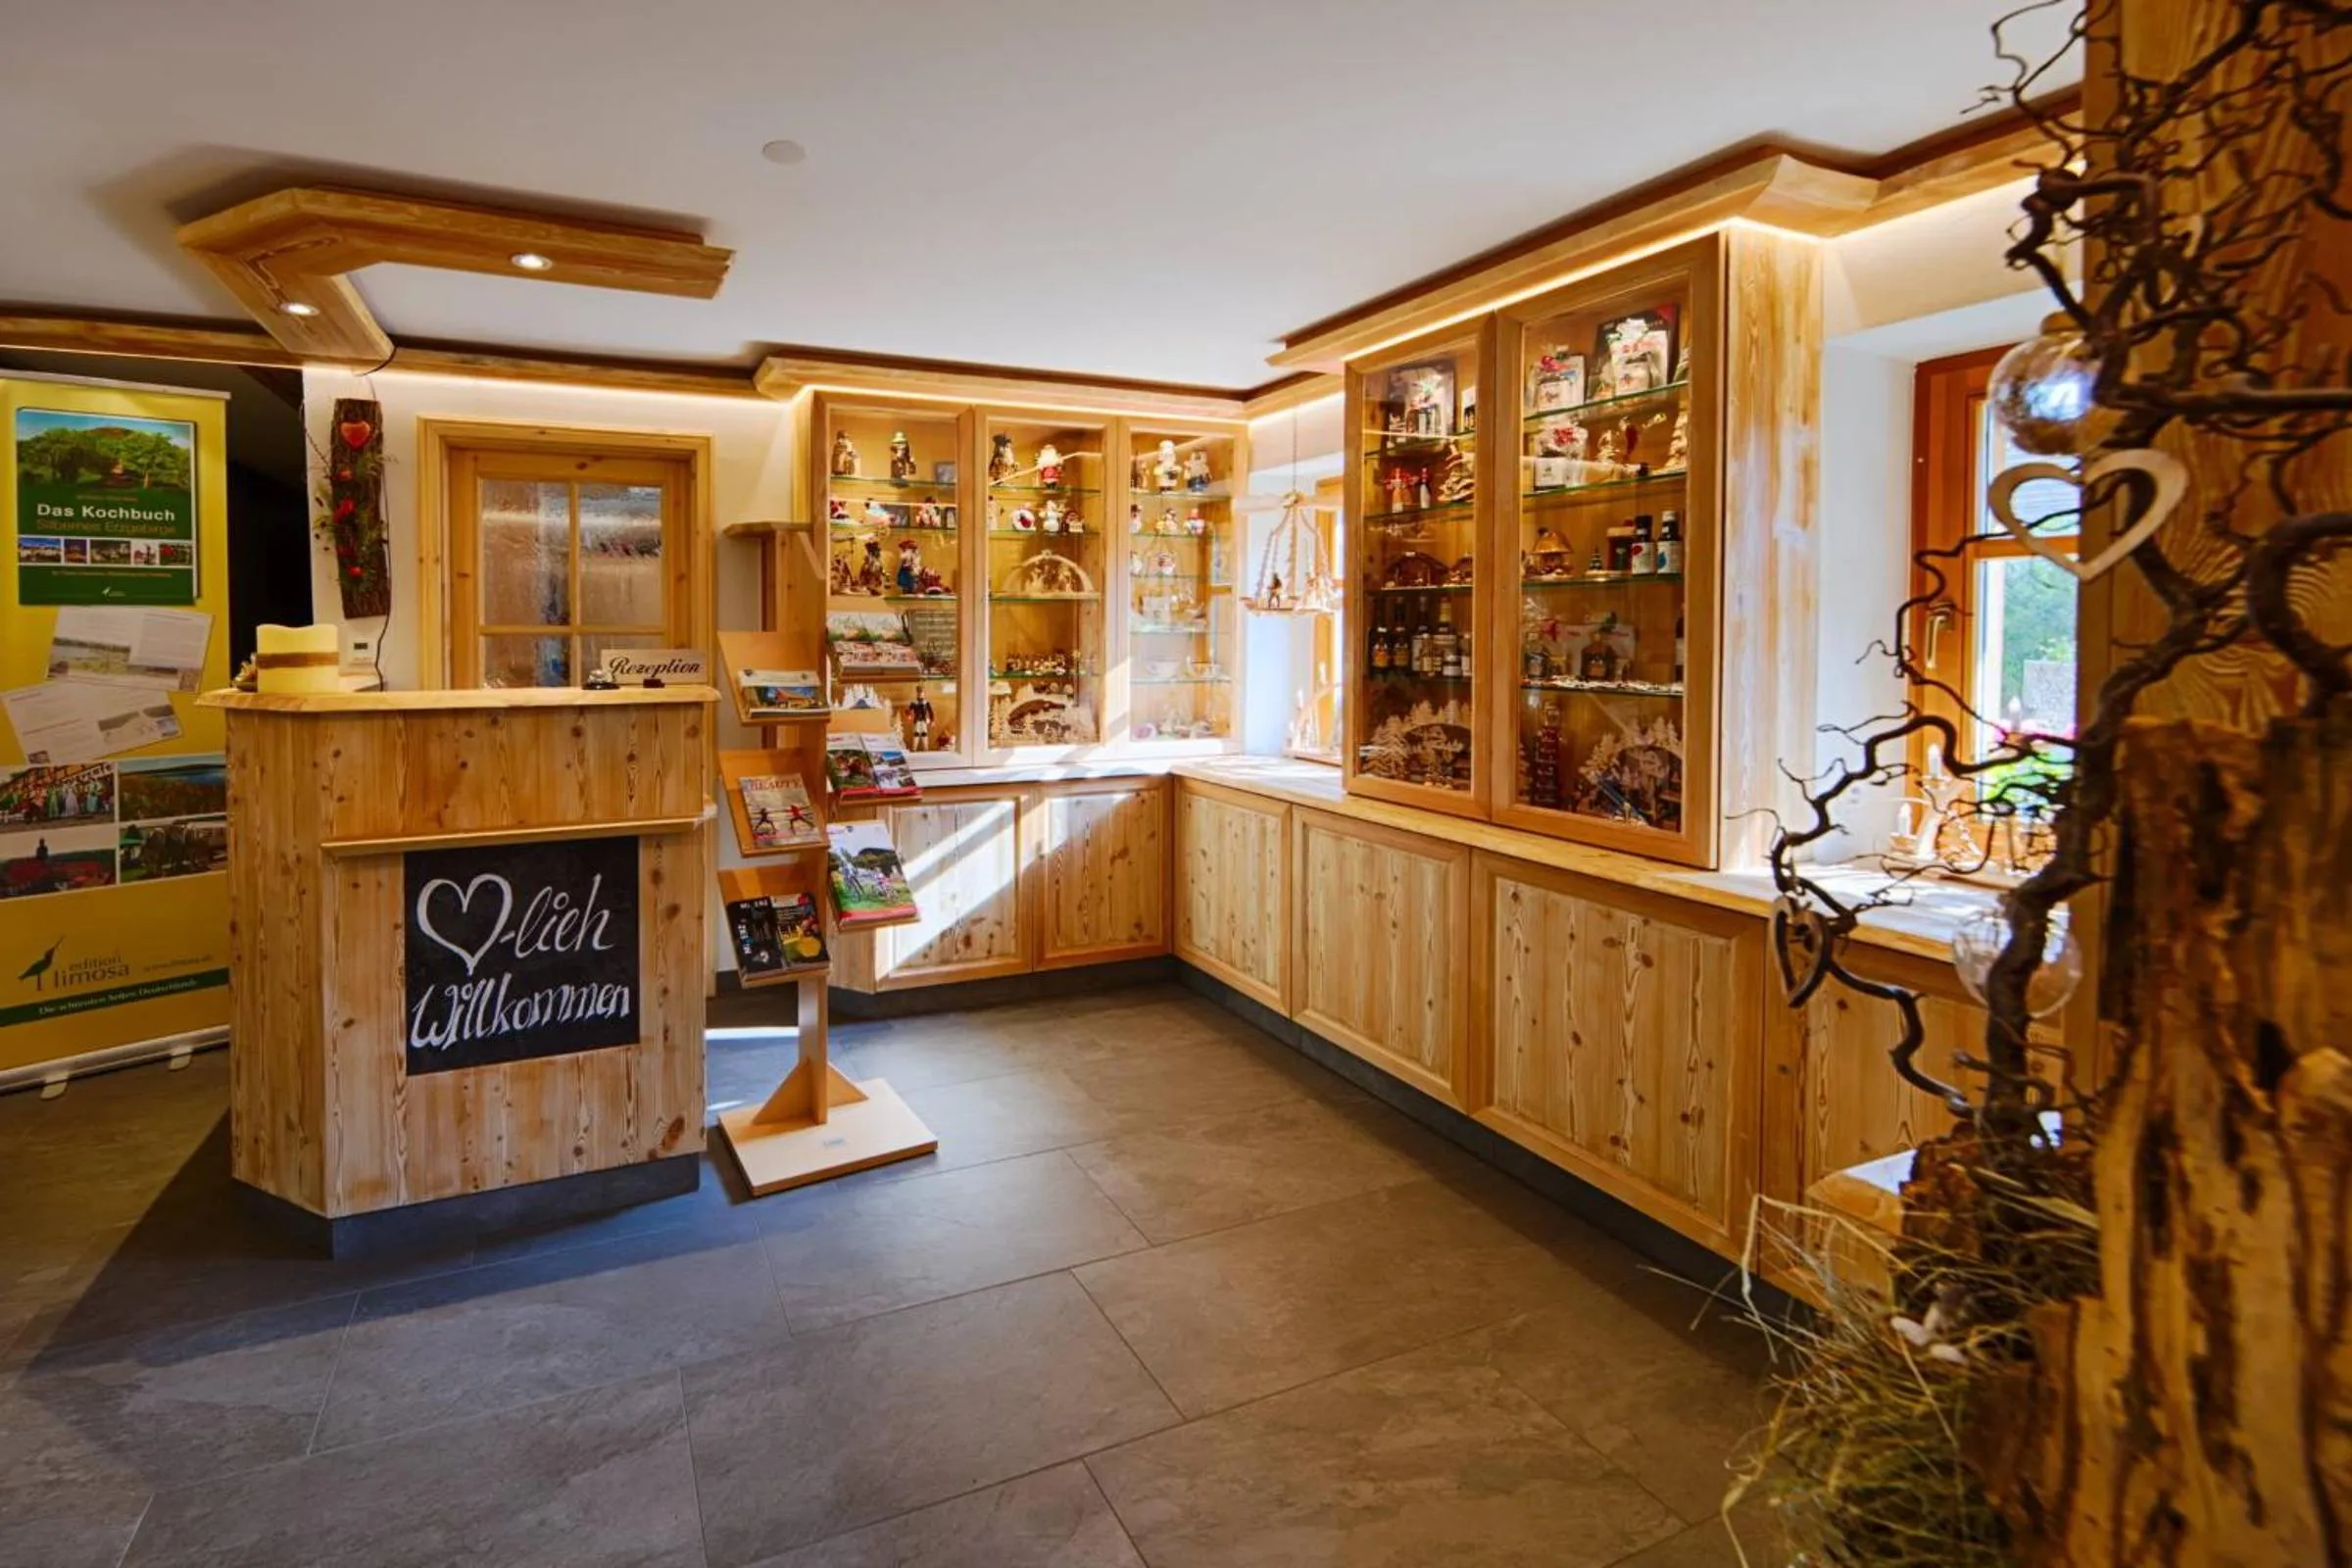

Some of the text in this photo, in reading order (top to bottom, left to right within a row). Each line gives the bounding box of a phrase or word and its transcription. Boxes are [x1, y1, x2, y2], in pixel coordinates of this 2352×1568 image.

[37, 504, 175, 521] Das Kochbuch
[609, 656, 701, 683] Rezeption
[54, 963, 130, 989] limosa
[69, 955, 122, 971] edition
[410, 972, 630, 1051] Willkommen
